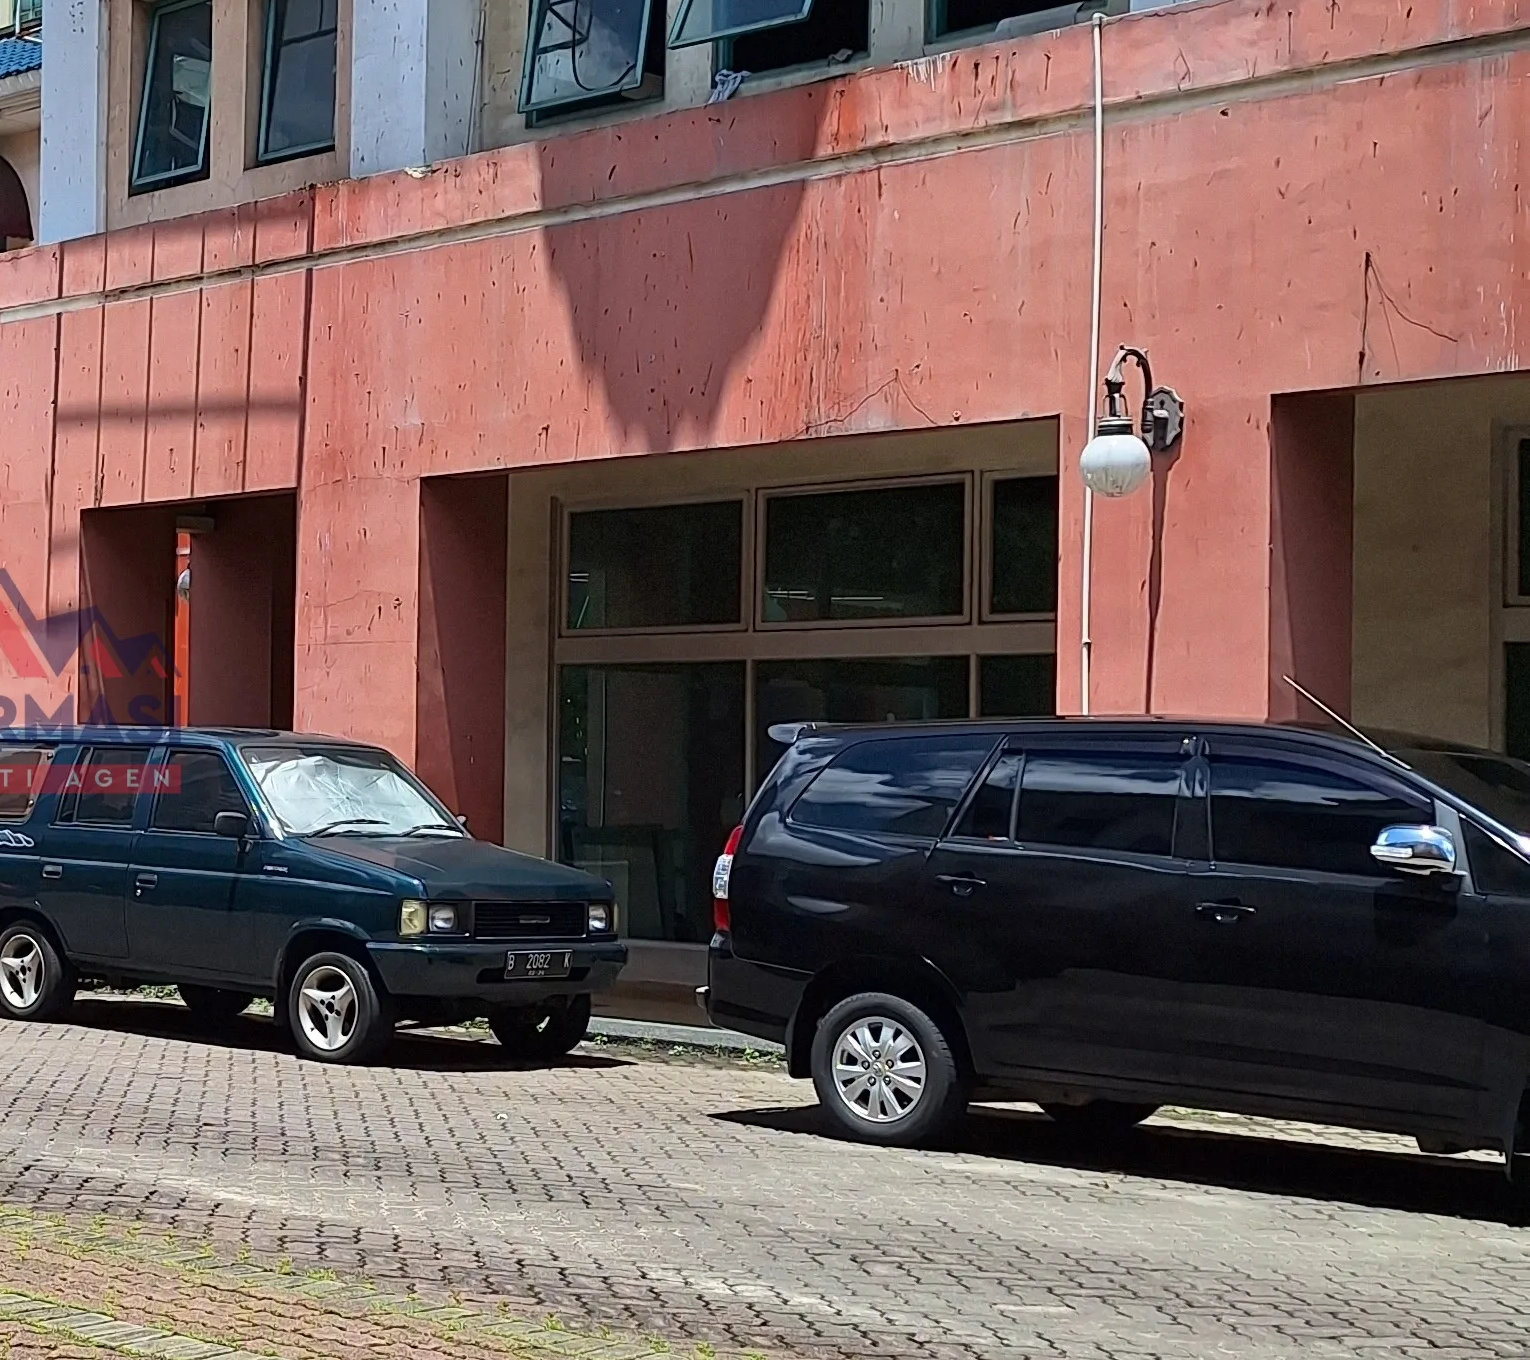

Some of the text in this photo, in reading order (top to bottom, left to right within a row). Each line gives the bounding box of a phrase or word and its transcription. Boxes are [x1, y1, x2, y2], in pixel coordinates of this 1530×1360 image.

[507, 952, 571, 971] B 2082 K
